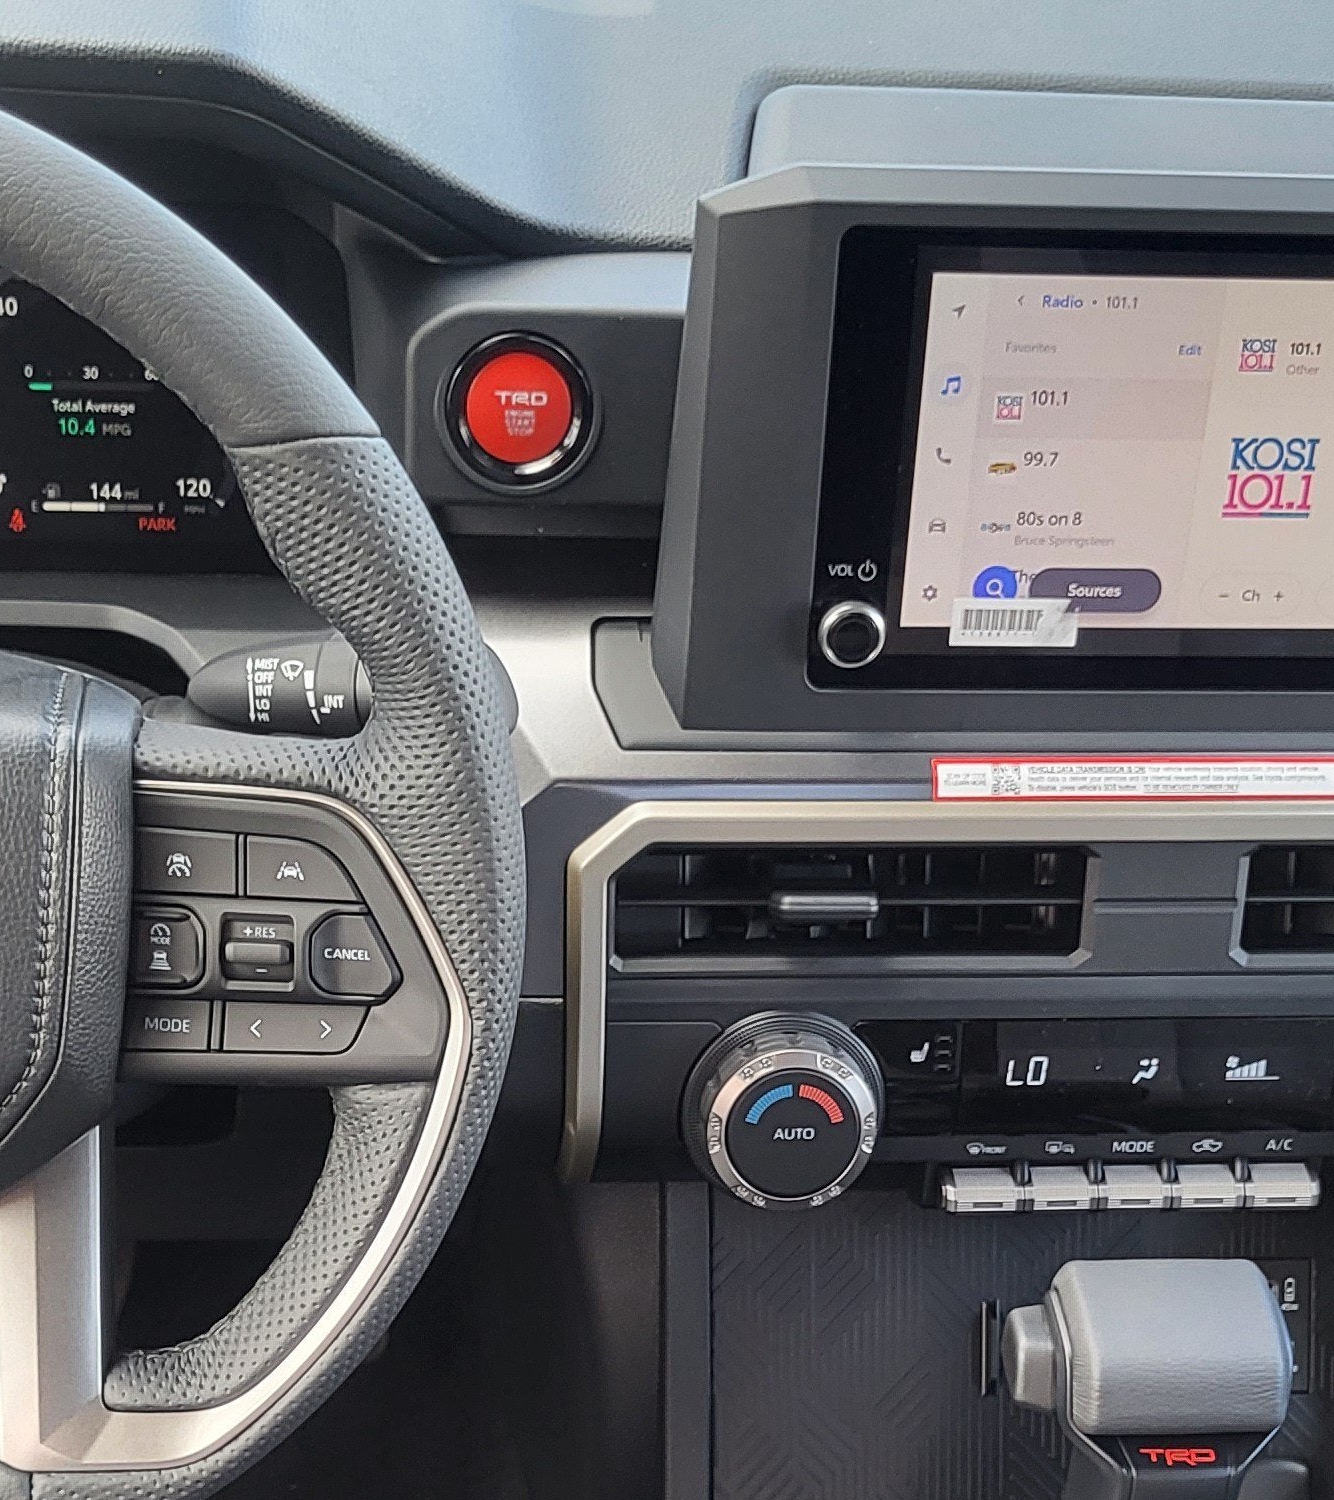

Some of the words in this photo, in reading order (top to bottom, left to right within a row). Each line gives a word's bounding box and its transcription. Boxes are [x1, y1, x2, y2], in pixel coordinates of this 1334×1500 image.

[1042, 294, 1084, 310] Radio
[1106, 296, 1138, 310] 101.1
[1178, 344, 1202, 356] Edit
[1241, 338, 1277, 353] KOSI
[1289, 342, 1321, 356] 101.1
[23, 363, 34, 379] 0
[82, 365, 99, 380] 30
[1285, 364, 1319, 376] Other
[494, 391, 548, 407] TRD
[1031, 390, 1069, 406] 101.1
[52, 398, 83, 414] Total
[85, 400, 136, 417] Average
[58, 418, 96, 436] 10.4
[102, 423, 132, 437] MPG
[1023, 451, 1059, 468] 99.7
[1229, 437, 1320, 472] KOSI
[90, 482, 122, 501] 144
[175, 477, 212, 499] 120
[1221, 473, 1313, 511] 101.1
[138, 516, 176, 532] PARK
[1016, 511, 1044, 527] 80s
[1048, 514, 1068, 527] on
[1071, 511, 1083, 527] 8
[1014, 535, 1045, 547] Bruce
[1048, 535, 1116, 549] Springsteen
[827, 563, 854, 577] VOL
[1067, 582, 1123, 599] Sources
[1241, 589, 1261, 602] Ch
[254, 657, 280, 671] MIST
[254, 671, 275, 684] OFF
[254, 684, 273, 697] INT
[256, 698, 271, 711] LO
[323, 694, 345, 709] INT
[257, 711, 270, 723] HI
[323, 947, 371, 962] CANCEL
[144, 1015, 191, 1033] MODE
[1006, 1055, 1050, 1087] LO
[773, 1127, 815, 1141] AUTO
[1111, 1140, 1156, 1154] MODE
[1265, 1137, 1294, 1152] A/C
[1139, 1447, 1216, 1466] TRD
